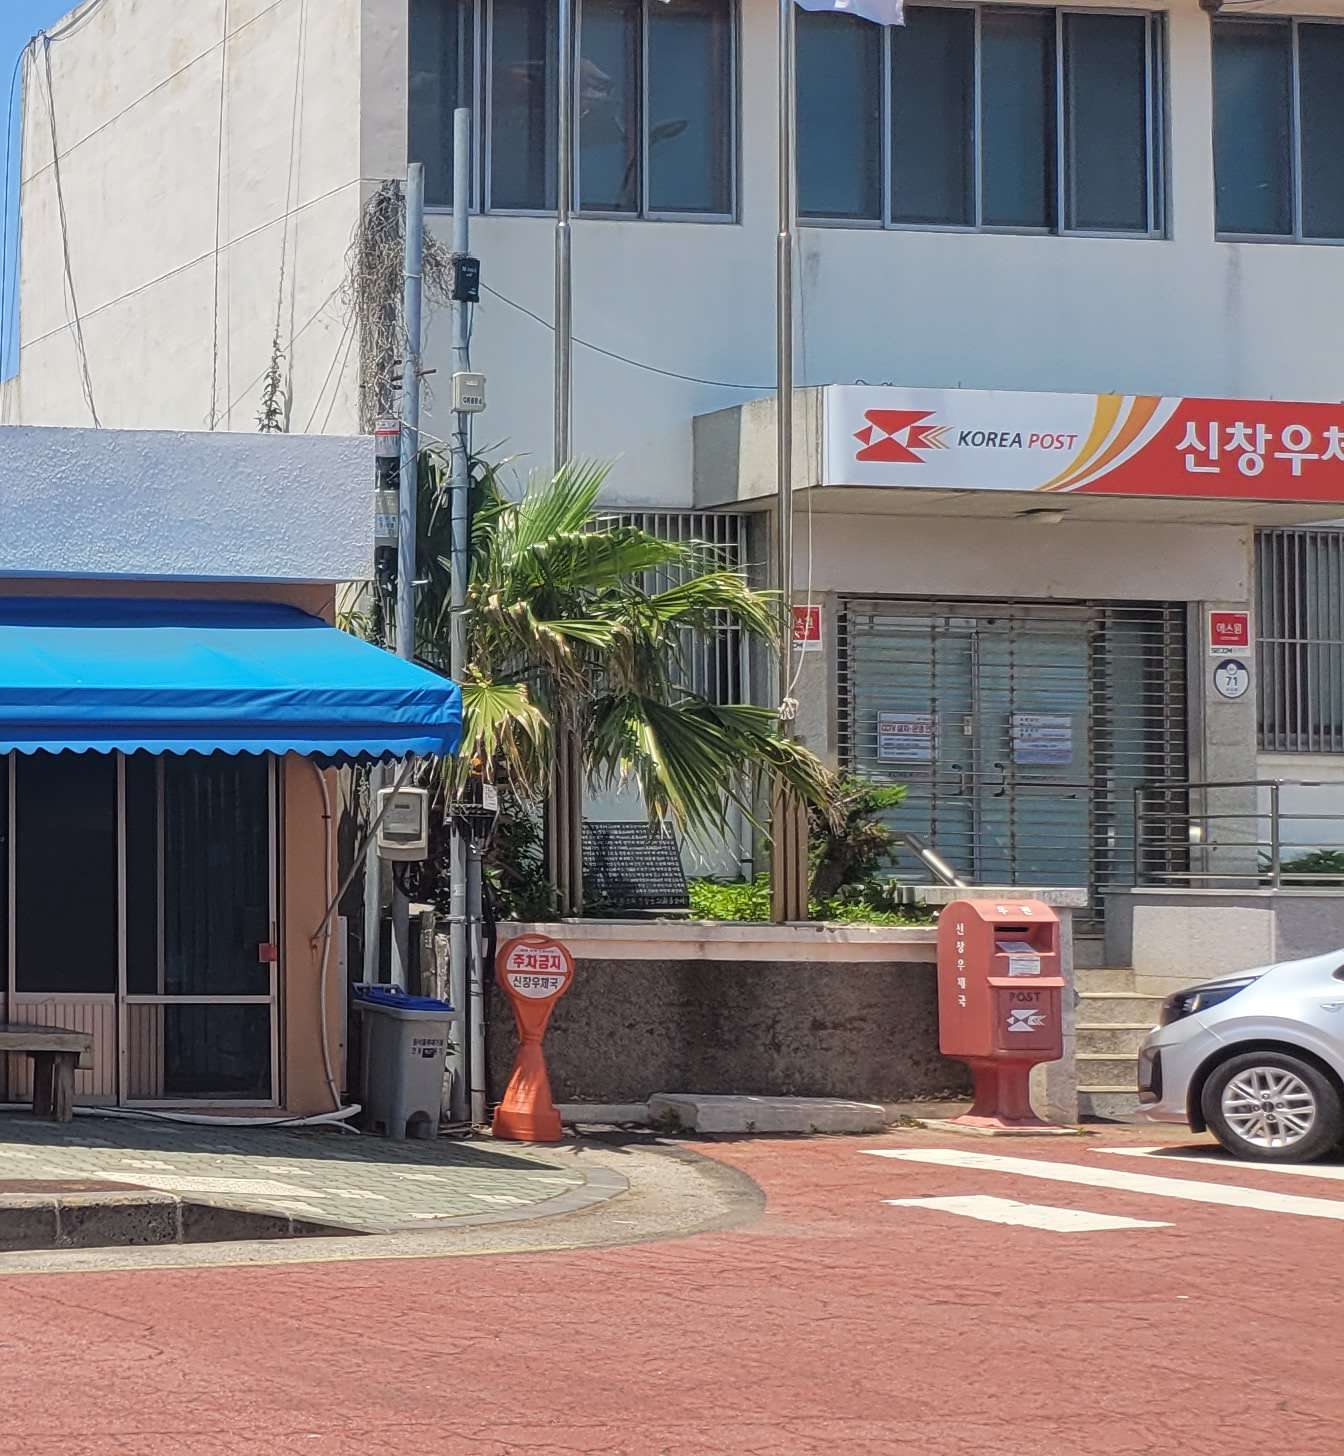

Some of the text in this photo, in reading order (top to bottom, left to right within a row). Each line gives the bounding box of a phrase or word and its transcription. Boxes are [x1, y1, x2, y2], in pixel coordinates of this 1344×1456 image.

[957, 430, 1079, 451] KOREA POST
[1225, 676, 1238, 687] 71
[513, 953, 561, 971] 주차금지
[1009, 991, 1041, 1002] POST
